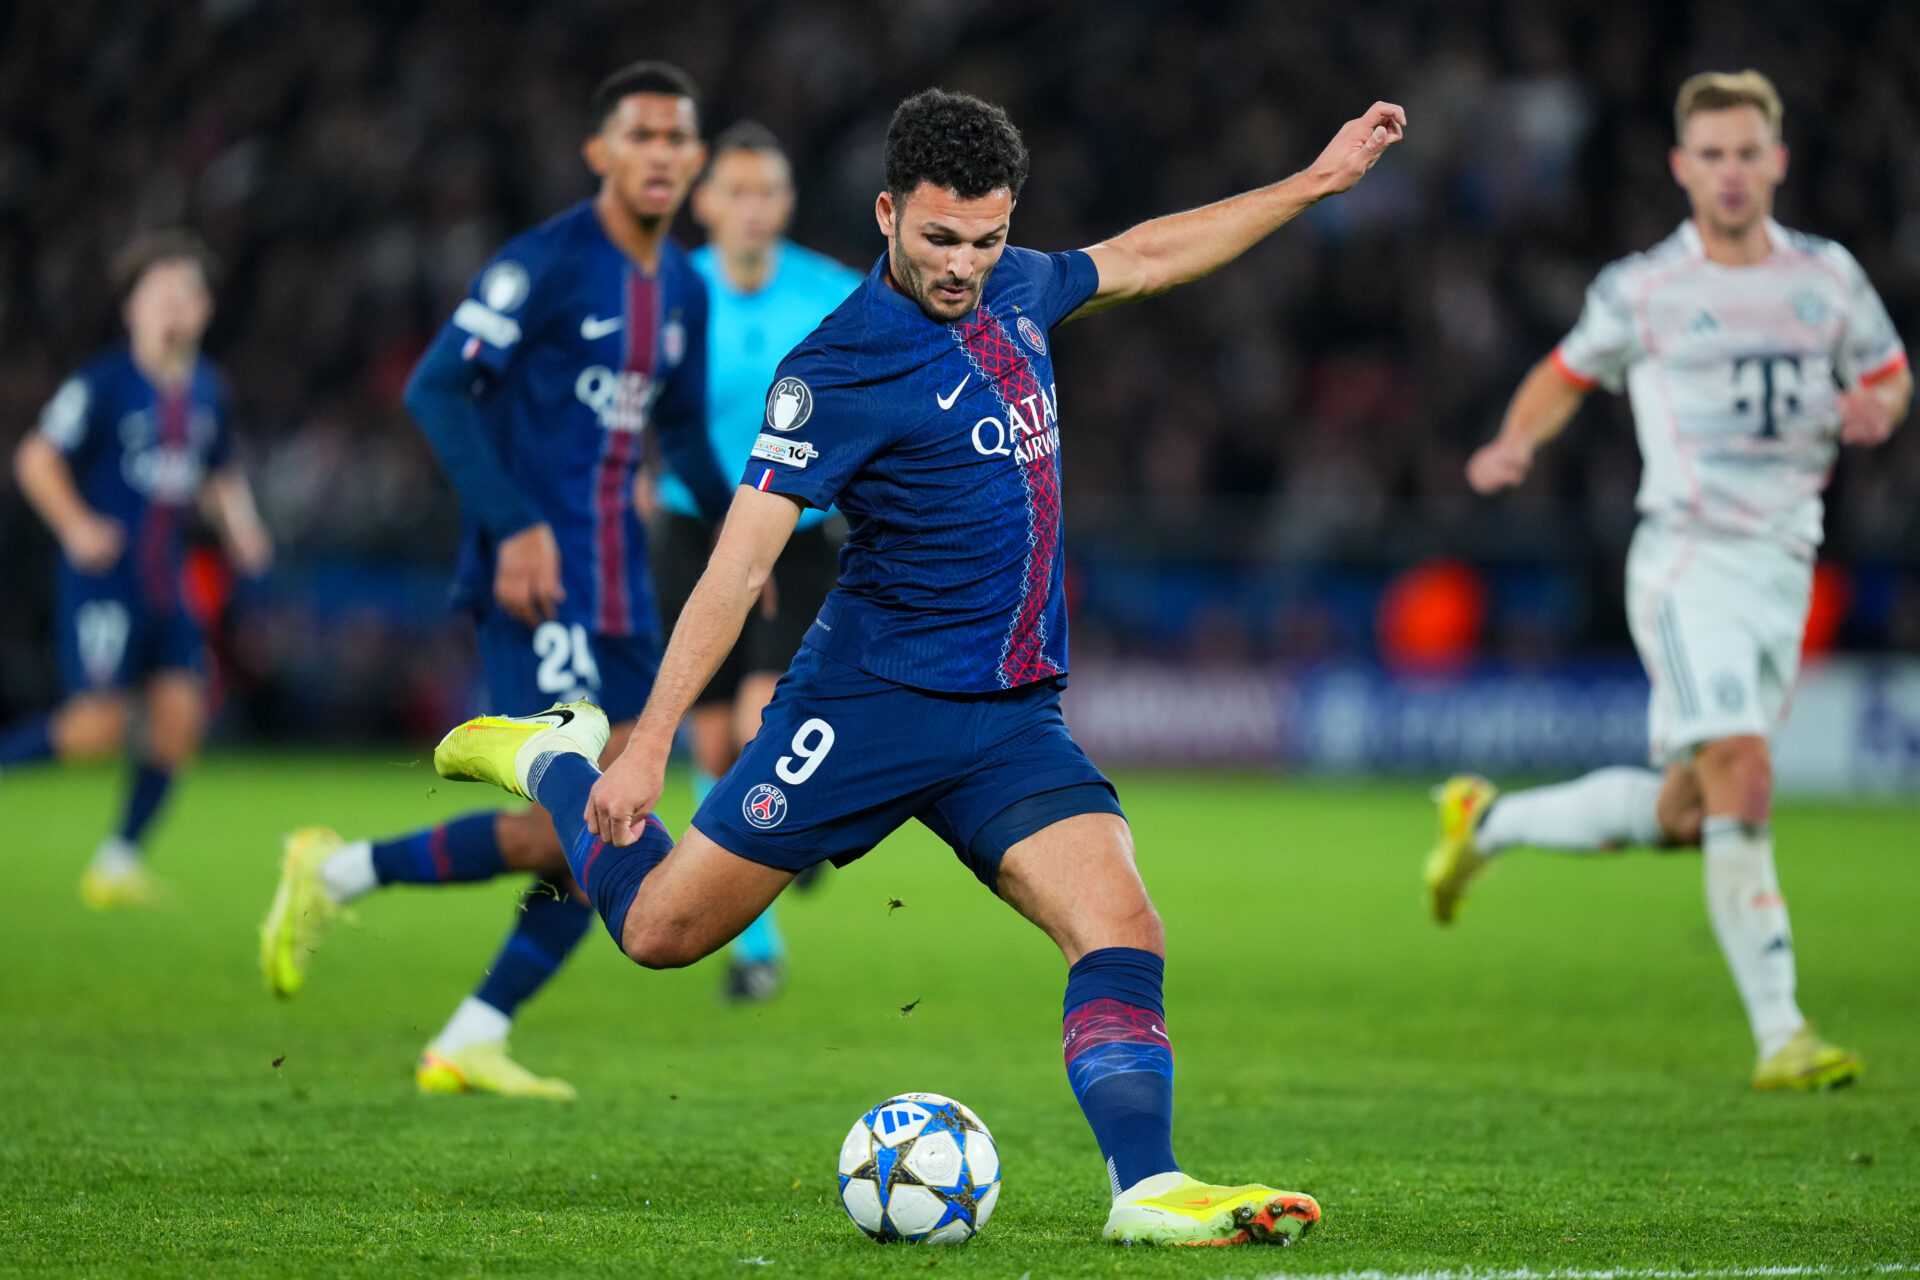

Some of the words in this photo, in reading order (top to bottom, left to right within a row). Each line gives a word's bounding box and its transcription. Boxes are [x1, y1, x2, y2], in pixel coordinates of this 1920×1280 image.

[1733, 353, 1802, 437] T
[788, 446, 807, 460] 10
[533, 620, 602, 694] 24
[775, 718, 835, 785] 9
[760, 785, 785, 806] PARIS
